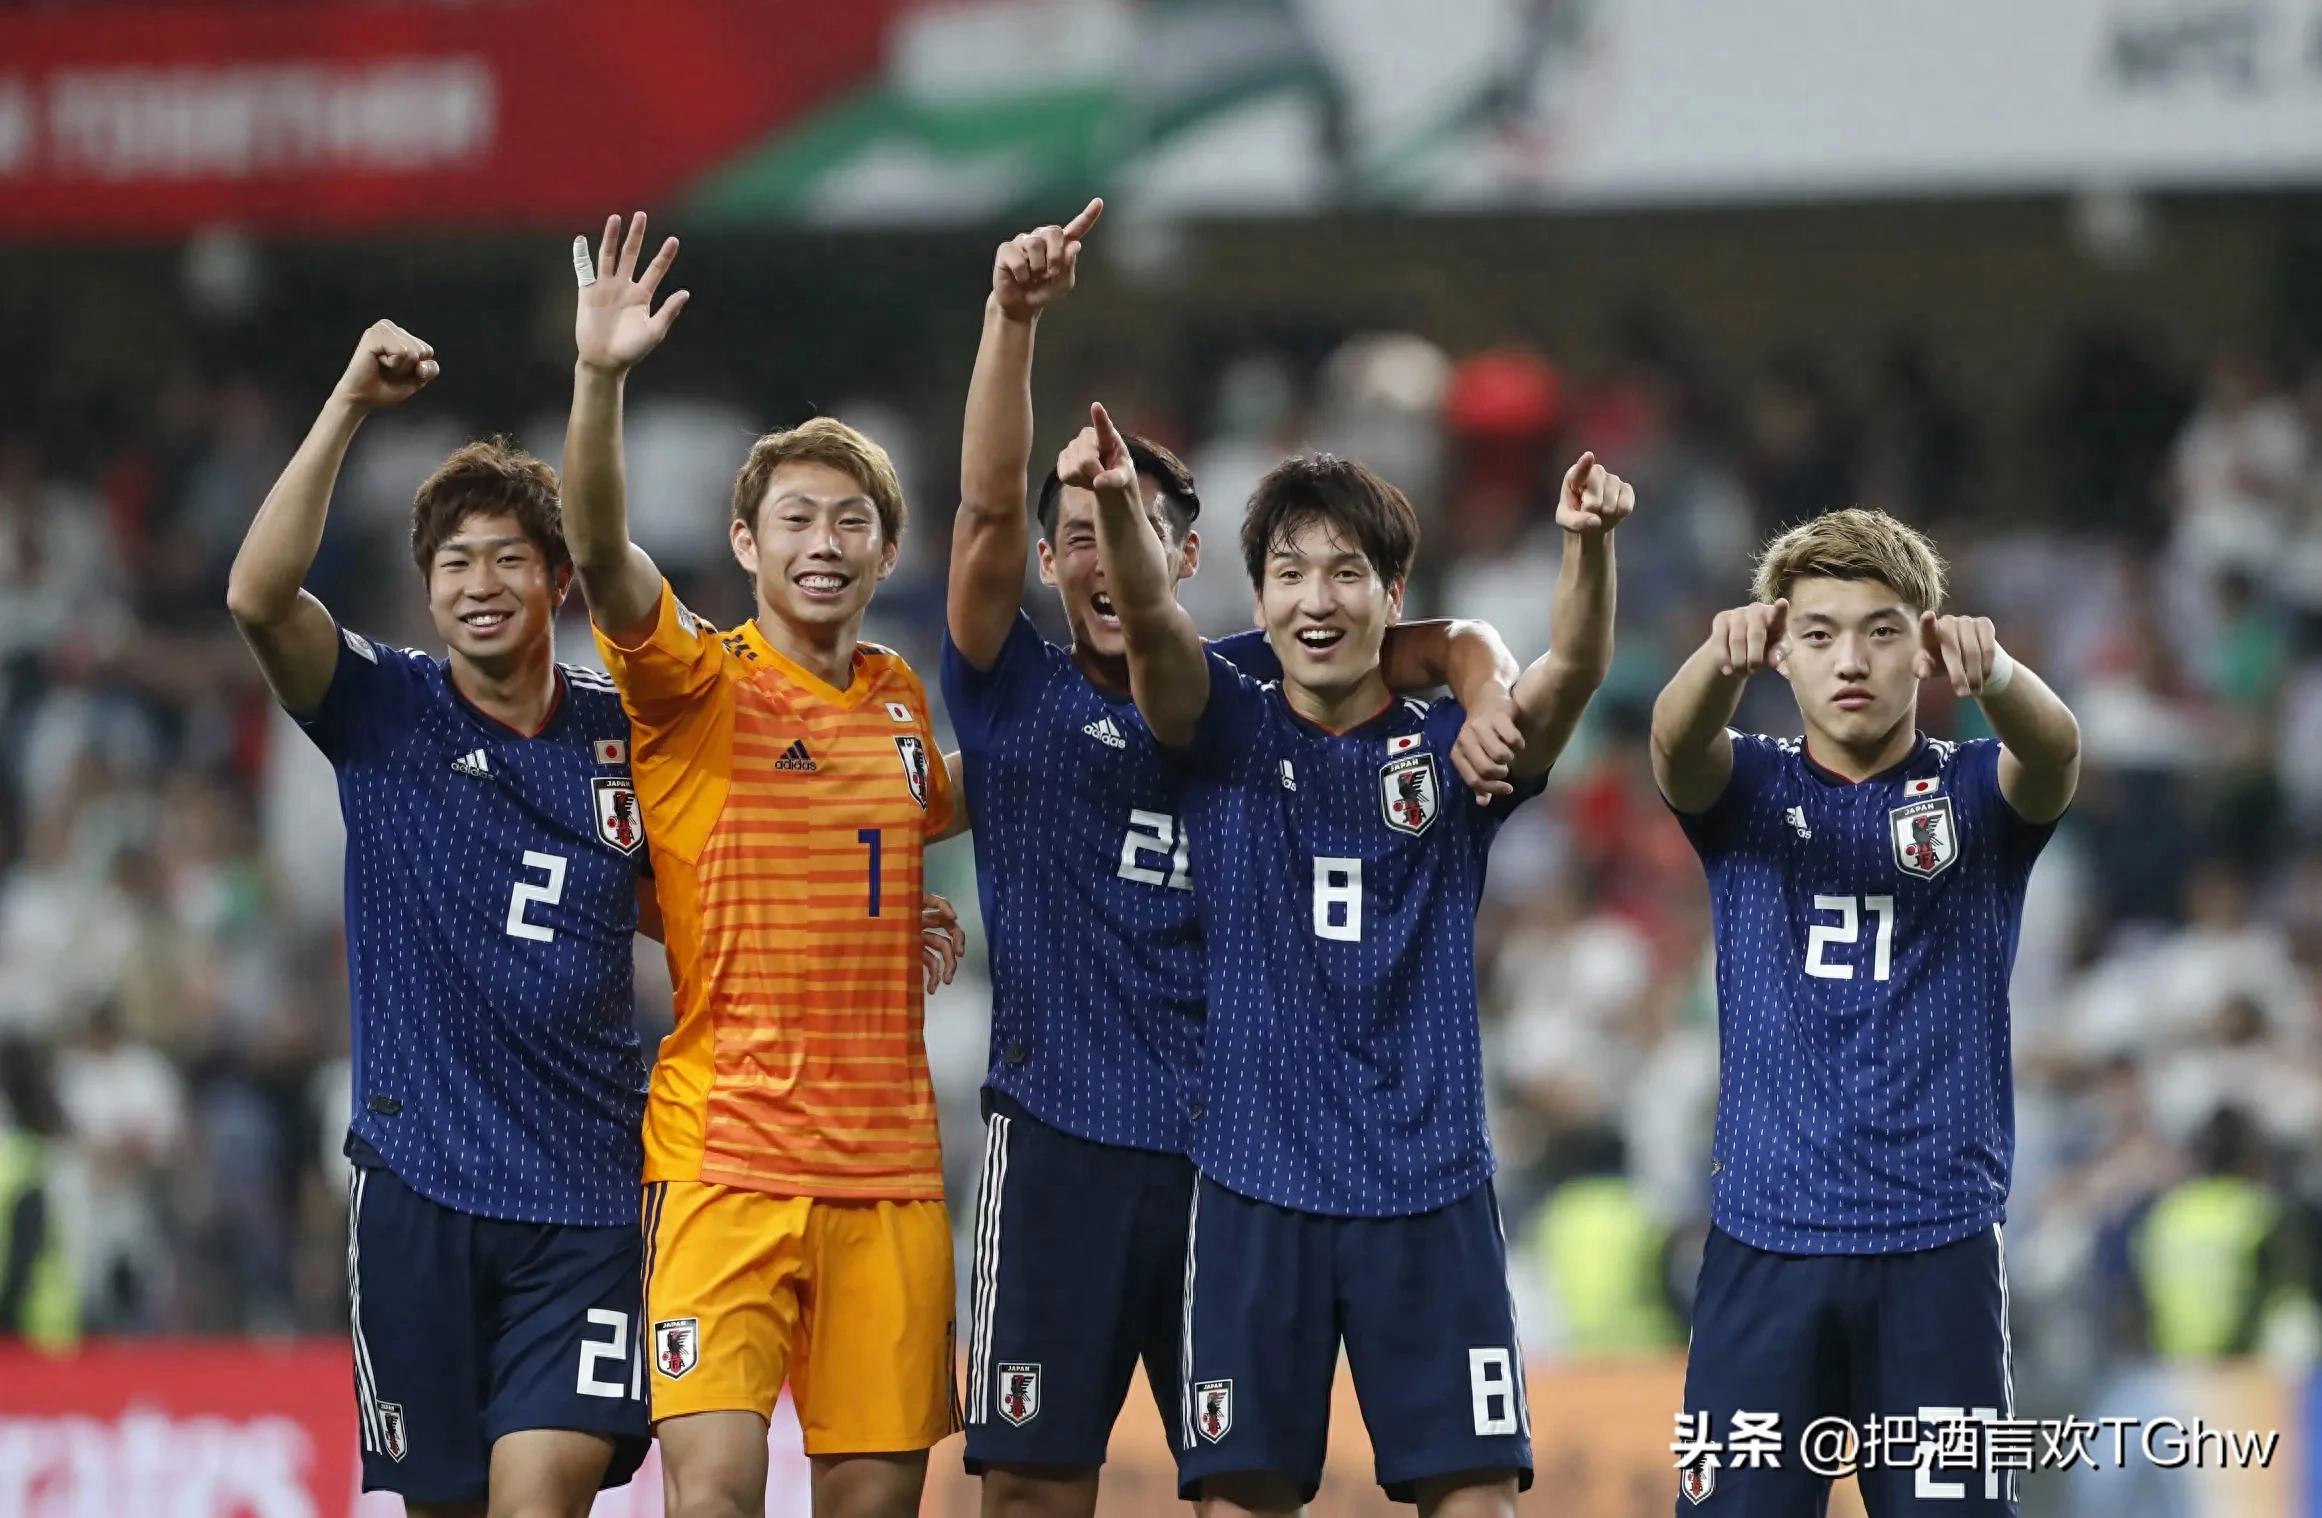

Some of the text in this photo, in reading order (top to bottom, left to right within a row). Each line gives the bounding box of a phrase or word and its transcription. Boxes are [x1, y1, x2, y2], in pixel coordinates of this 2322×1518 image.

[1083, 724, 1126, 749] adidas
[451, 762, 496, 781] adidas
[775, 759, 817, 771] adidas
[1391, 758, 1419, 772] JAPAN
[1904, 803, 1935, 816] JAPAN
[858, 828, 881, 917] 1
[506, 850, 567, 942] 2
[1313, 856, 1362, 942] 8
[1804, 895, 1894, 981] 21
[662, 1321, 687, 1329] JAPAN
[1203, 1382, 1223, 1390] JAPAN
[1468, 1347, 1518, 1436] 8
